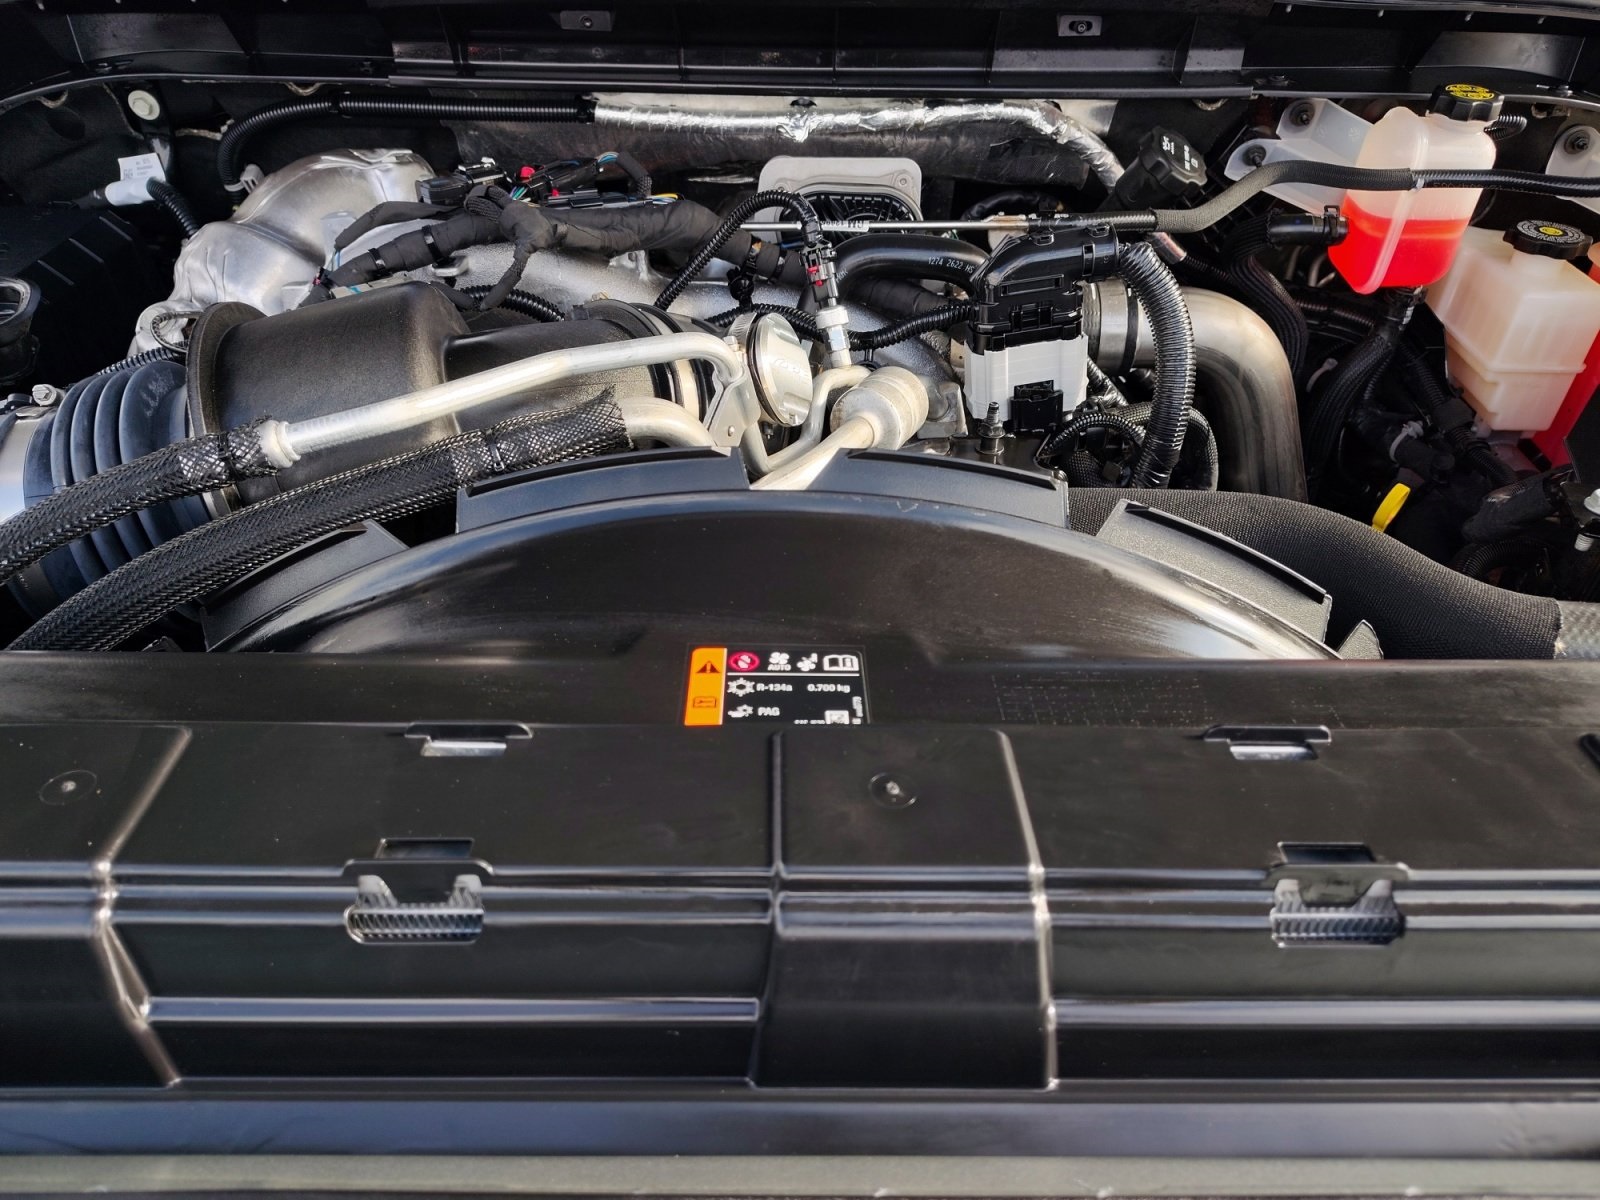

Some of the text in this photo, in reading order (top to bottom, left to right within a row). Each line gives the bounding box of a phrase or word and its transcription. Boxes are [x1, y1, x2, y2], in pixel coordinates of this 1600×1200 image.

[928, 256, 944, 266] 1274
[946, 259, 963, 270] 2622
[756, 683, 851, 694] R-134a 0.700 kg
[757, 707, 780, 716] PAG
